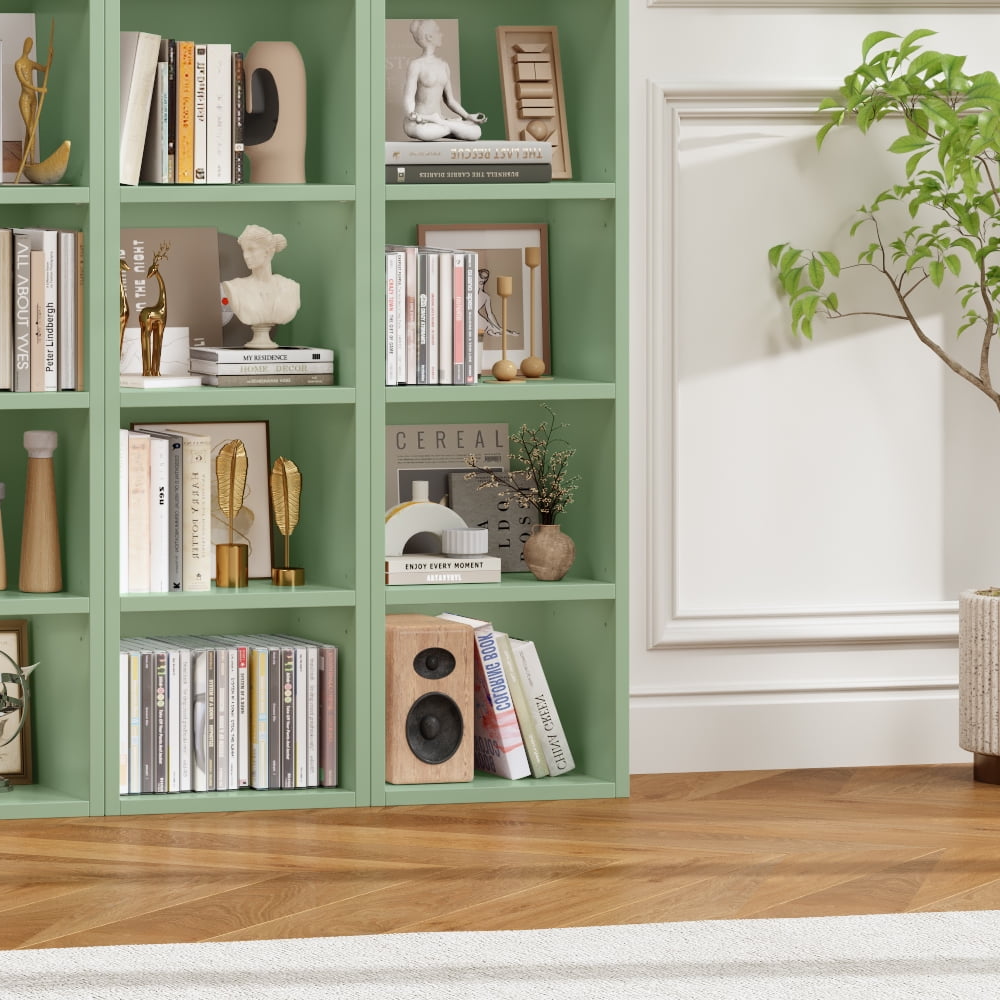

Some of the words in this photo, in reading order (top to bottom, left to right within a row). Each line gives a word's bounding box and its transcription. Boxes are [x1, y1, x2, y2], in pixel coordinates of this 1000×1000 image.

[450, 148, 491, 159] RESCUE
[494, 148, 520, 159] LAST
[522, 148, 543, 159] THE
[17, 242, 29, 270] ALL
[134, 278, 146, 299] THE
[17, 274, 29, 327] ABOUT
[45, 302, 55, 347] Lindbergh
[17, 333, 29, 370] YVES
[45, 348, 54, 372] Peter
[239, 365, 268, 373] HOME
[275, 364, 308, 372] DECOR
[396, 429, 504, 450] CEREAL
[429, 562, 452, 570] EVERY
